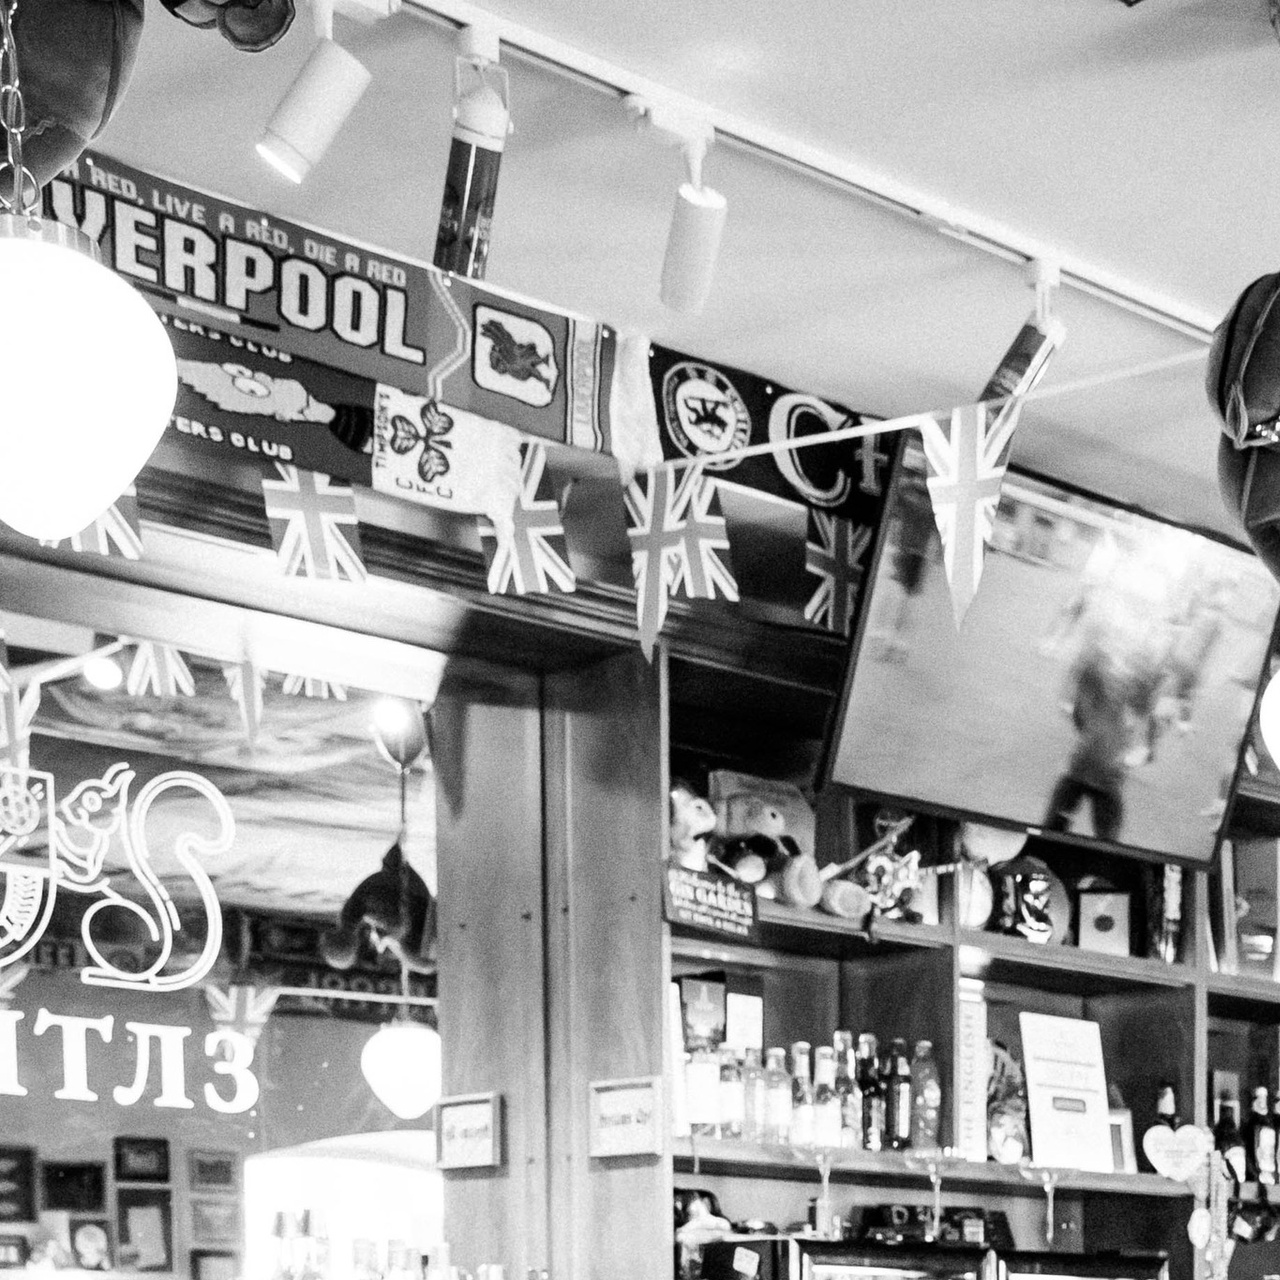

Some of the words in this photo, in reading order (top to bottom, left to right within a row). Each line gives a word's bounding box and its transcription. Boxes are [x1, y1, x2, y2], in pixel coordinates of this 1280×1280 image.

[50, 178, 425, 364] VERPOOL
[151, 189, 206, 225] LIVE
[219, 212, 236, 234] A
[246, 219, 295, 254] RED,
[305, 238, 338, 268] DIE
[345, 253, 360, 274] A
[367, 259, 407, 289] RED
